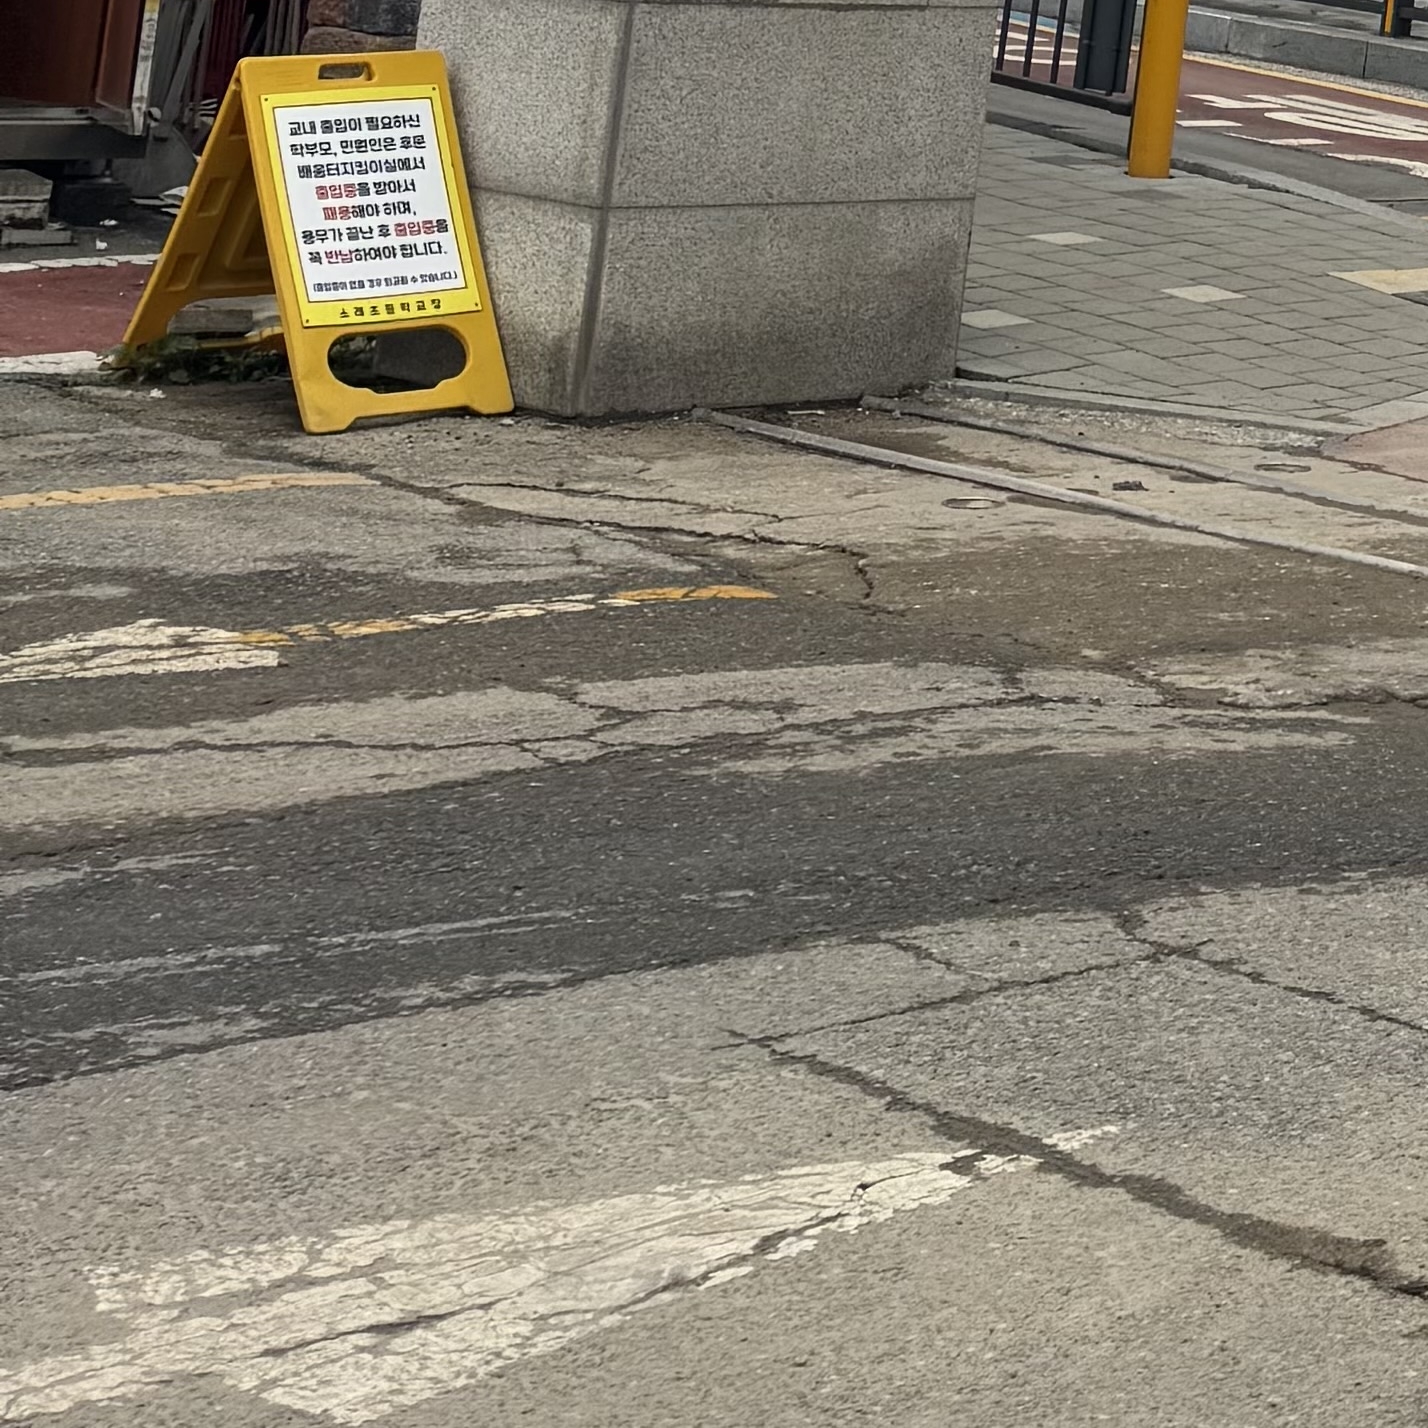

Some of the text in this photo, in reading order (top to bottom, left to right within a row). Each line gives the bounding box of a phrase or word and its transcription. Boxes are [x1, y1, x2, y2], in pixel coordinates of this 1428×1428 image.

[288, 113, 421, 136] 교내 출입이 필요하신
[377, 223, 391, 238] 후
